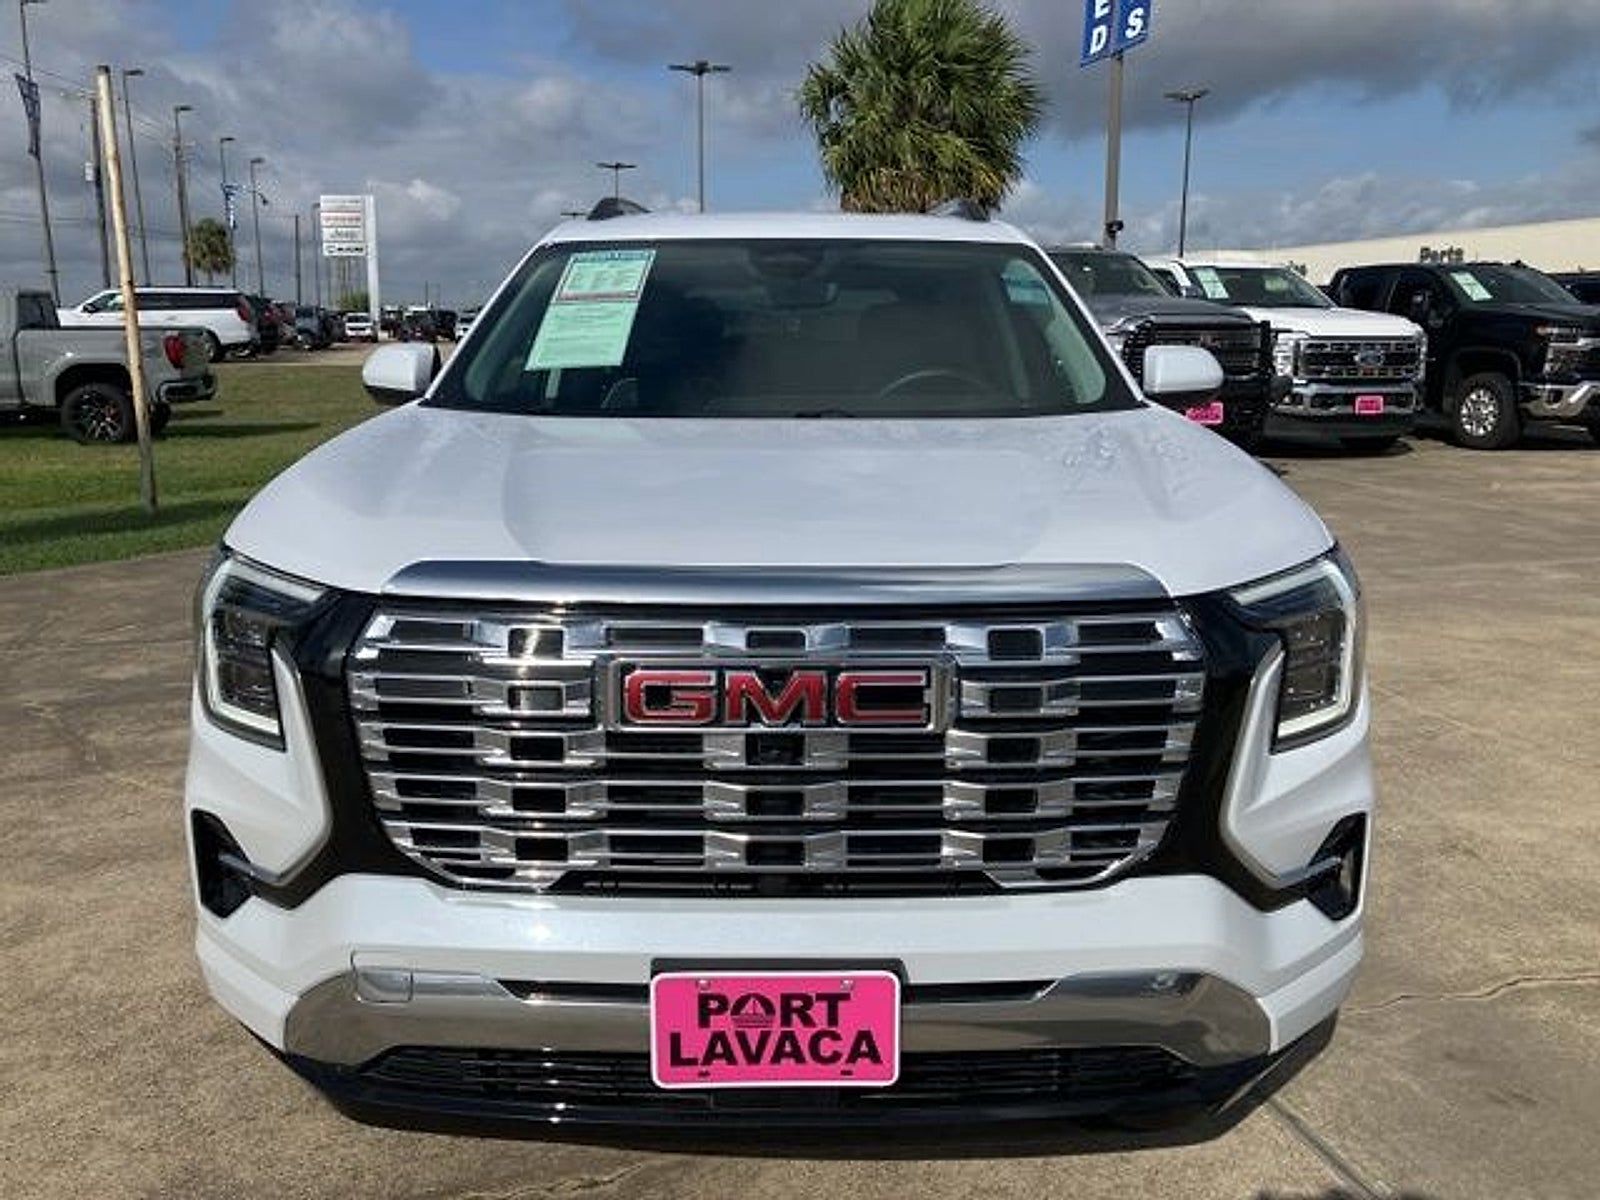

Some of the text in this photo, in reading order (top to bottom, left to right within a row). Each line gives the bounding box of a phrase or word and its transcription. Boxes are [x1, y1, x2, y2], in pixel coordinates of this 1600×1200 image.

[625, 669, 926, 726] GMC
[697, 993, 851, 1028] PORT
[669, 1030, 883, 1067] LAVACA
